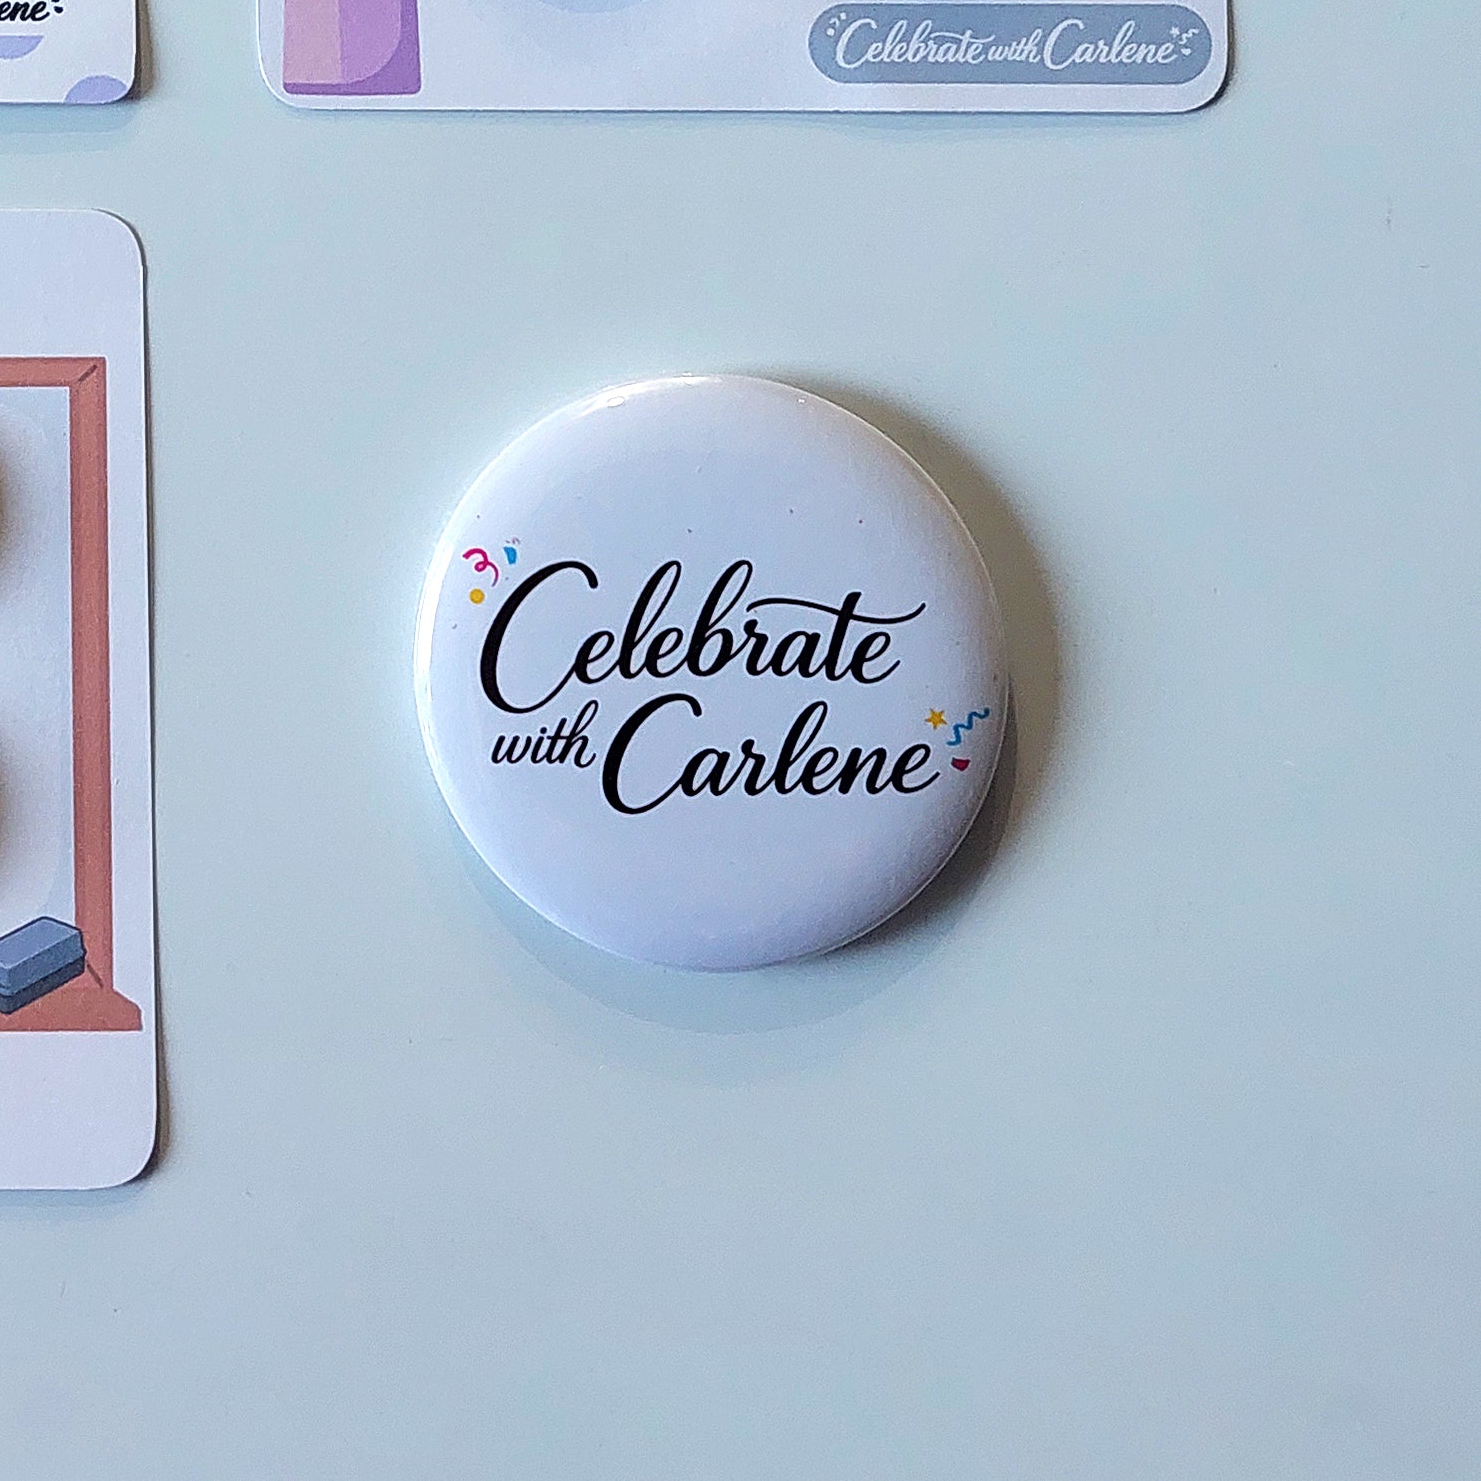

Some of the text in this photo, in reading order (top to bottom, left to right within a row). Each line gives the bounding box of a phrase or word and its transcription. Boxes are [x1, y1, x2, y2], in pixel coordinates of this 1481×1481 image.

[835, 18, 1177, 70] Celebrate with Carlene
[479, 559, 926, 714] Celebrate
[490, 692, 941, 815] with Carlene
